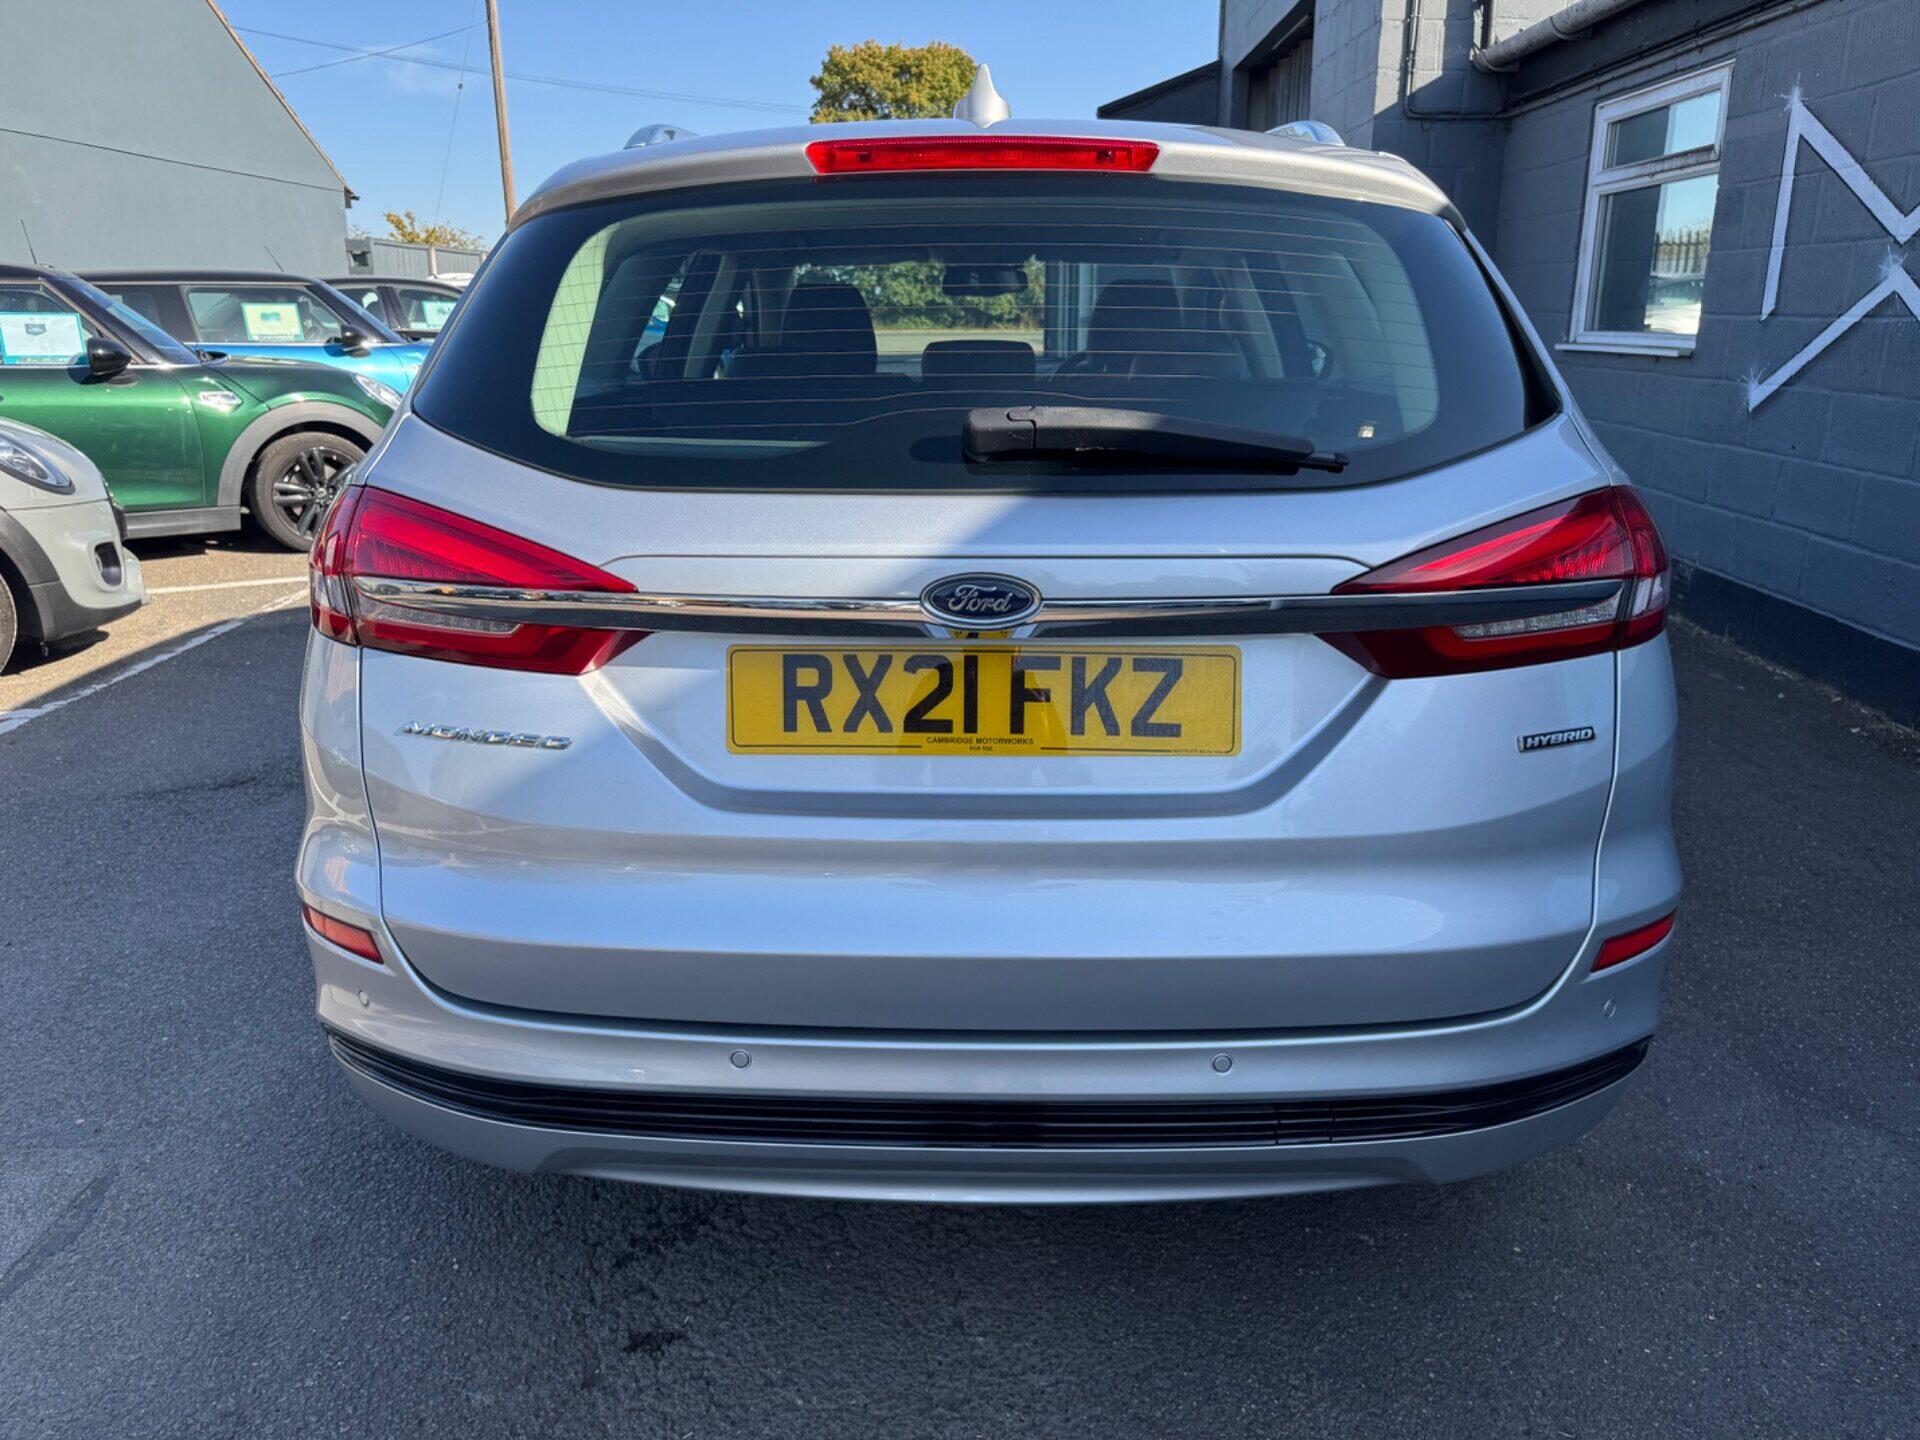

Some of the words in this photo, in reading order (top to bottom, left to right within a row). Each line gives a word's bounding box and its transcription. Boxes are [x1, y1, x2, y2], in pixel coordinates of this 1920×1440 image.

[948, 584, 1014, 612] Ford
[782, 654, 979, 734] RX21
[1009, 655, 1184, 738] FKZ
[926, 736, 973, 745] CAMBRIDGE
[975, 737, 1035, 746] MOTORWORKS
[1525, 728, 1593, 749] HYBRID
